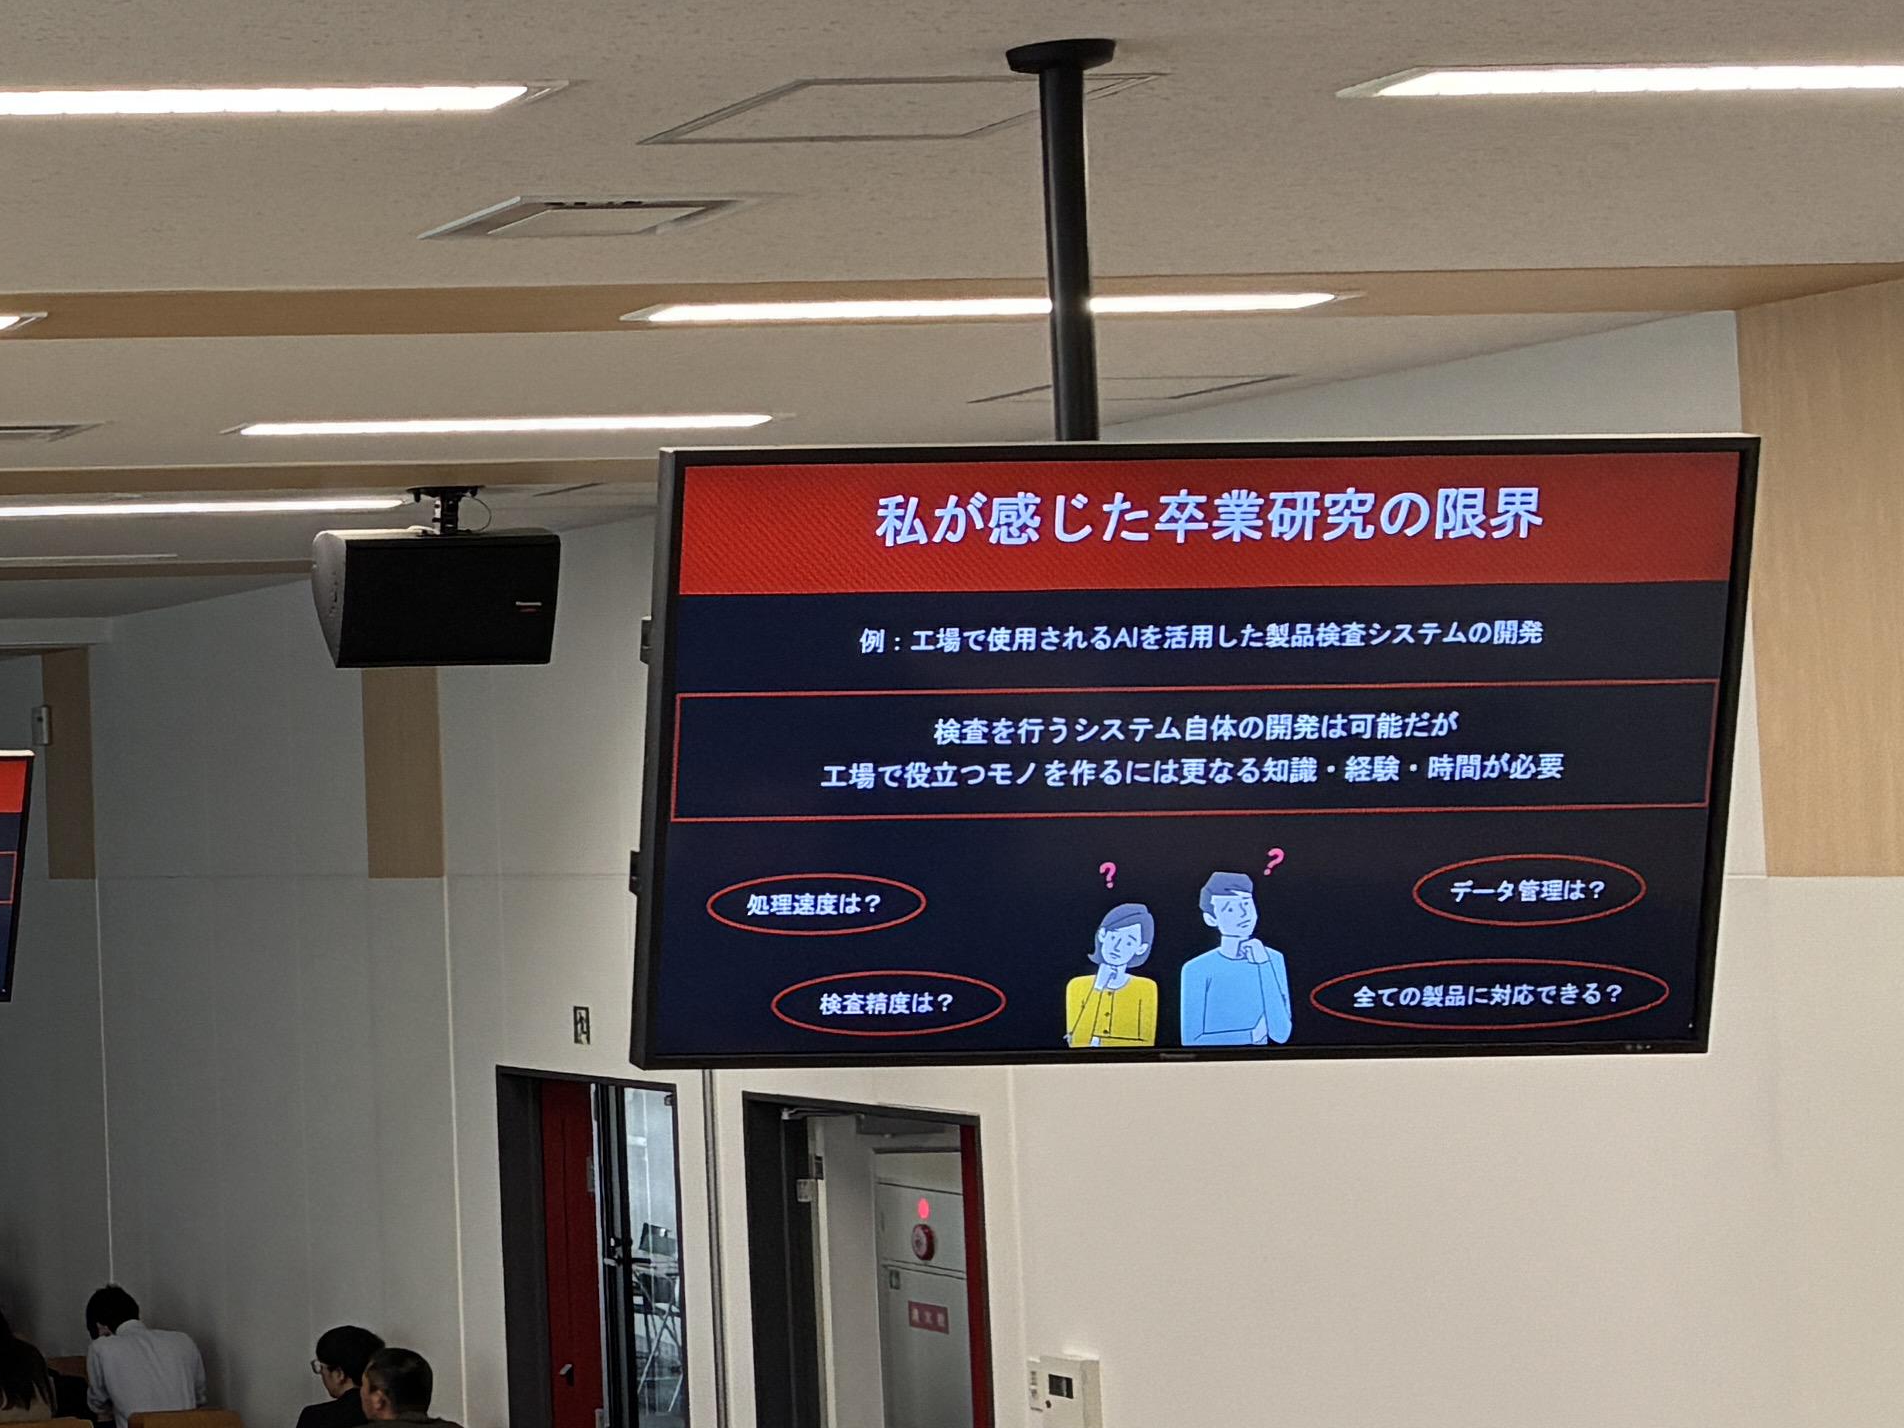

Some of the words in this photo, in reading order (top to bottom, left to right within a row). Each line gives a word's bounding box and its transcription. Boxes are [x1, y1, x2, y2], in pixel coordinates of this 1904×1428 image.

[875, 487, 1543, 547] 私が感じた卒業研究の限界
[859, 619, 1544, 654] 例：工場で使用されるAIを活用した製品検査システムの開発
[933, 710, 1460, 746] 検査を行うシステム自体の開発は可能だが
[820, 752, 1565, 790] 工場で役立つモノを作るには更なる知識・経験・時間が必要
[746, 892, 881, 916] 処理速度は？
[1450, 879, 1605, 903] データ管理は？
[819, 991, 954, 1016] 検査精度は？
[1353, 982, 1623, 1008] 全ての製品に対応できる？
